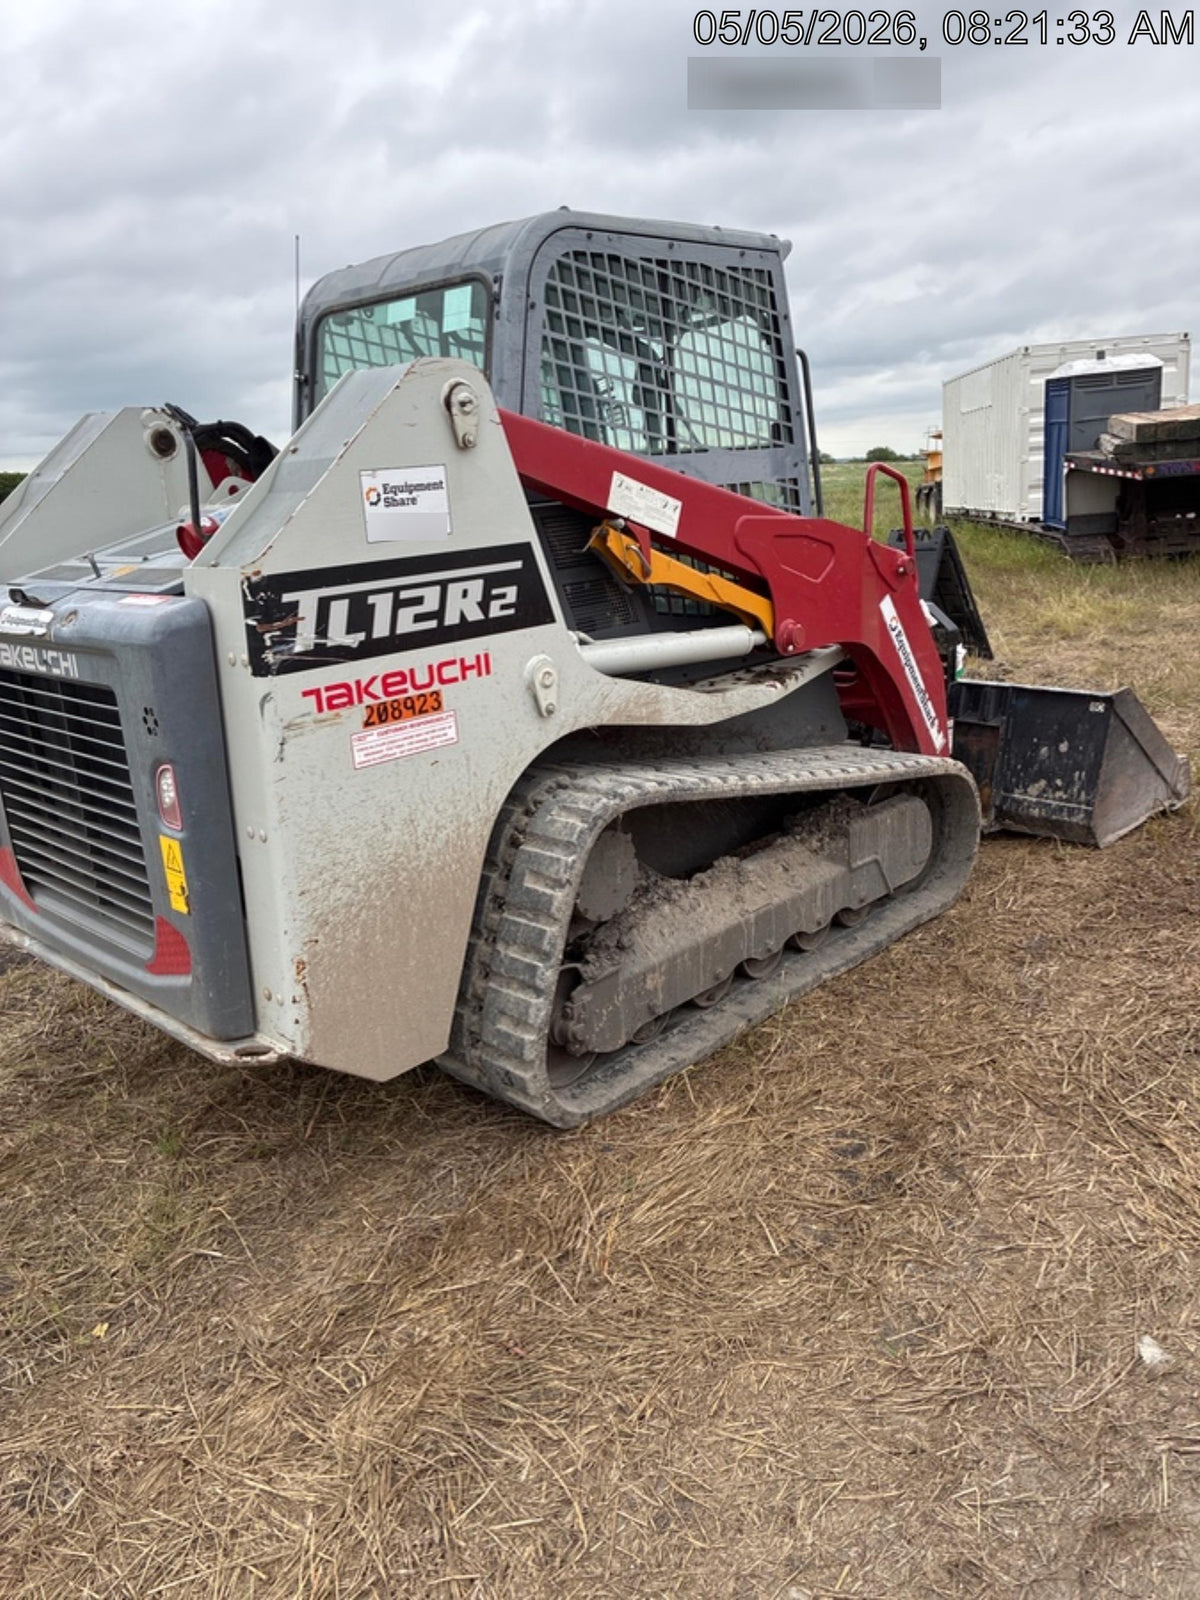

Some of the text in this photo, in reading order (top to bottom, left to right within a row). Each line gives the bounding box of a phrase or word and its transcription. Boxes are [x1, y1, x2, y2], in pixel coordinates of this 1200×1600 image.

[382, 480, 444, 496] Equipment
[383, 496, 418, 508] Share
[281, 560, 523, 653] TL12R2
[301, 652, 491, 713] TAKEUCHI
[363, 690, 442, 727] 208923
